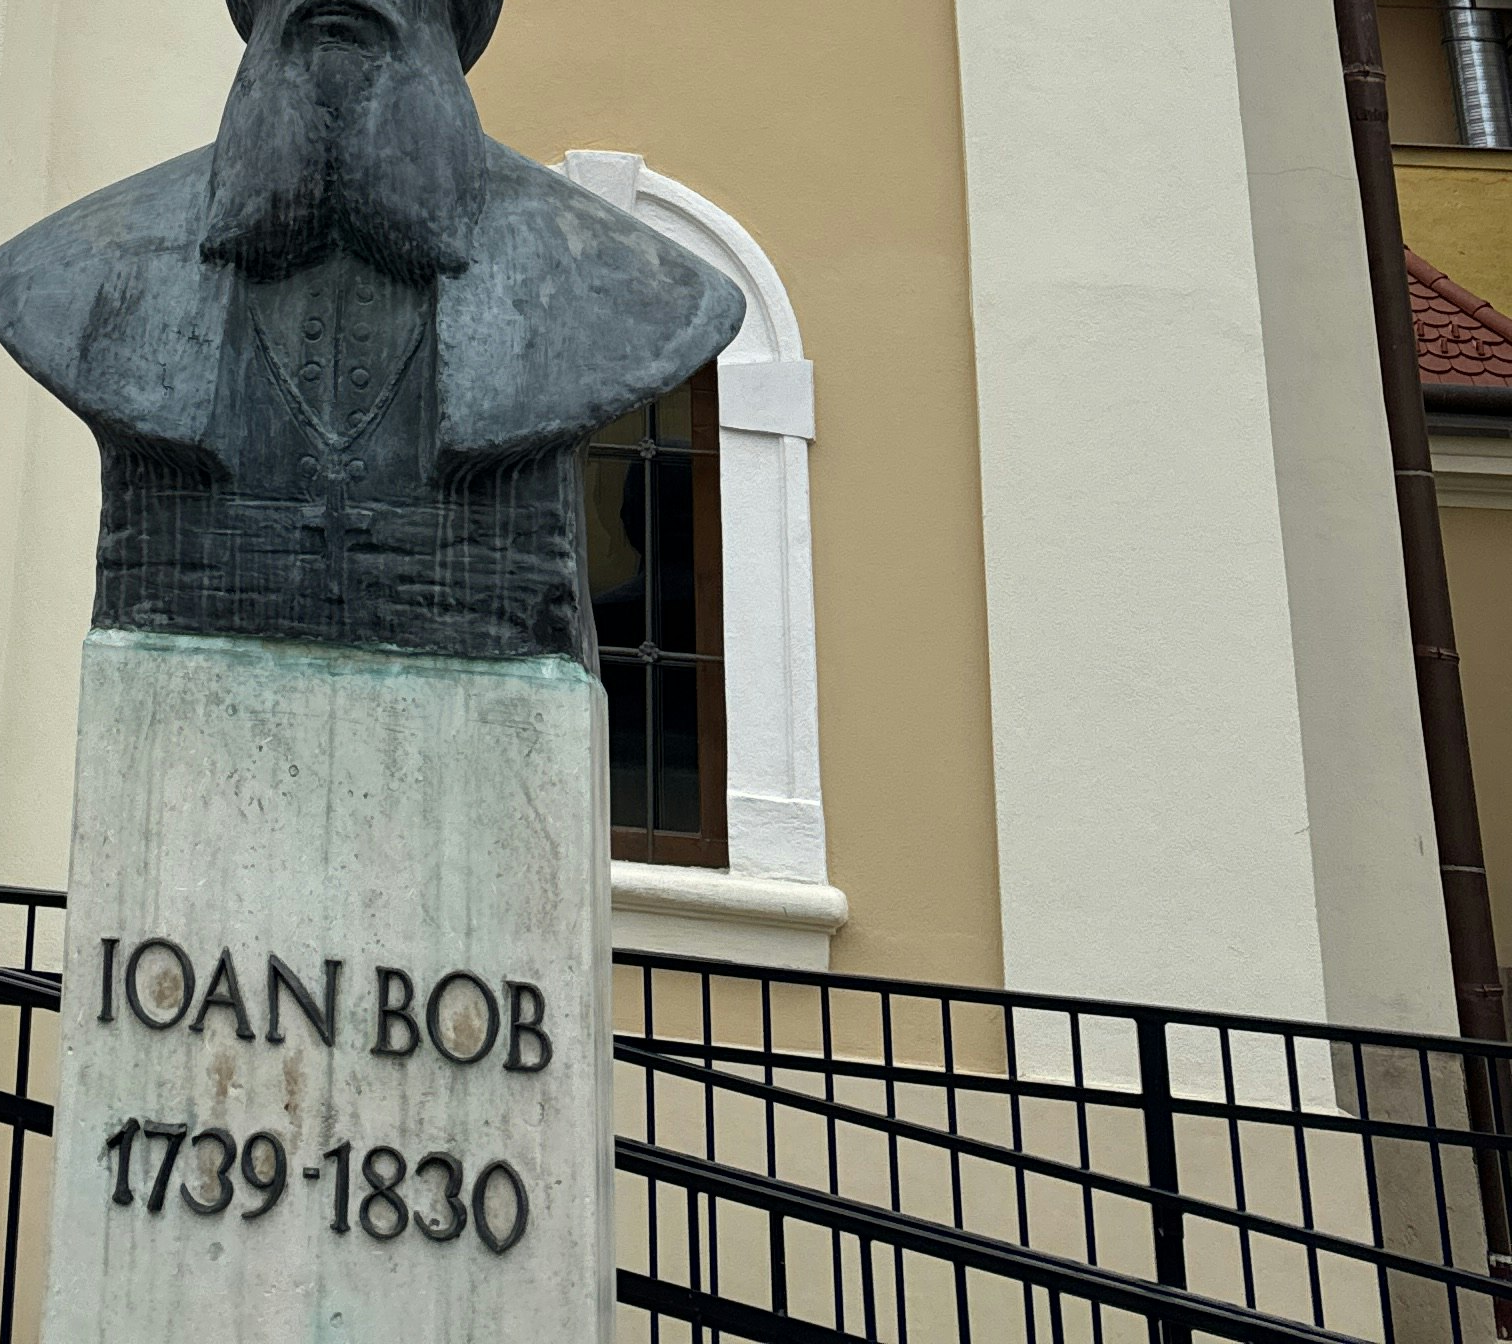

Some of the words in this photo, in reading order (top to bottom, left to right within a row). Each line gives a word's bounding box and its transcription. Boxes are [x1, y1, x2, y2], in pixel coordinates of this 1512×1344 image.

[97, 937, 343, 1048] IOAN
[369, 964, 554, 1073] BOB
[106, 1117, 530, 1254] 1739-1830
